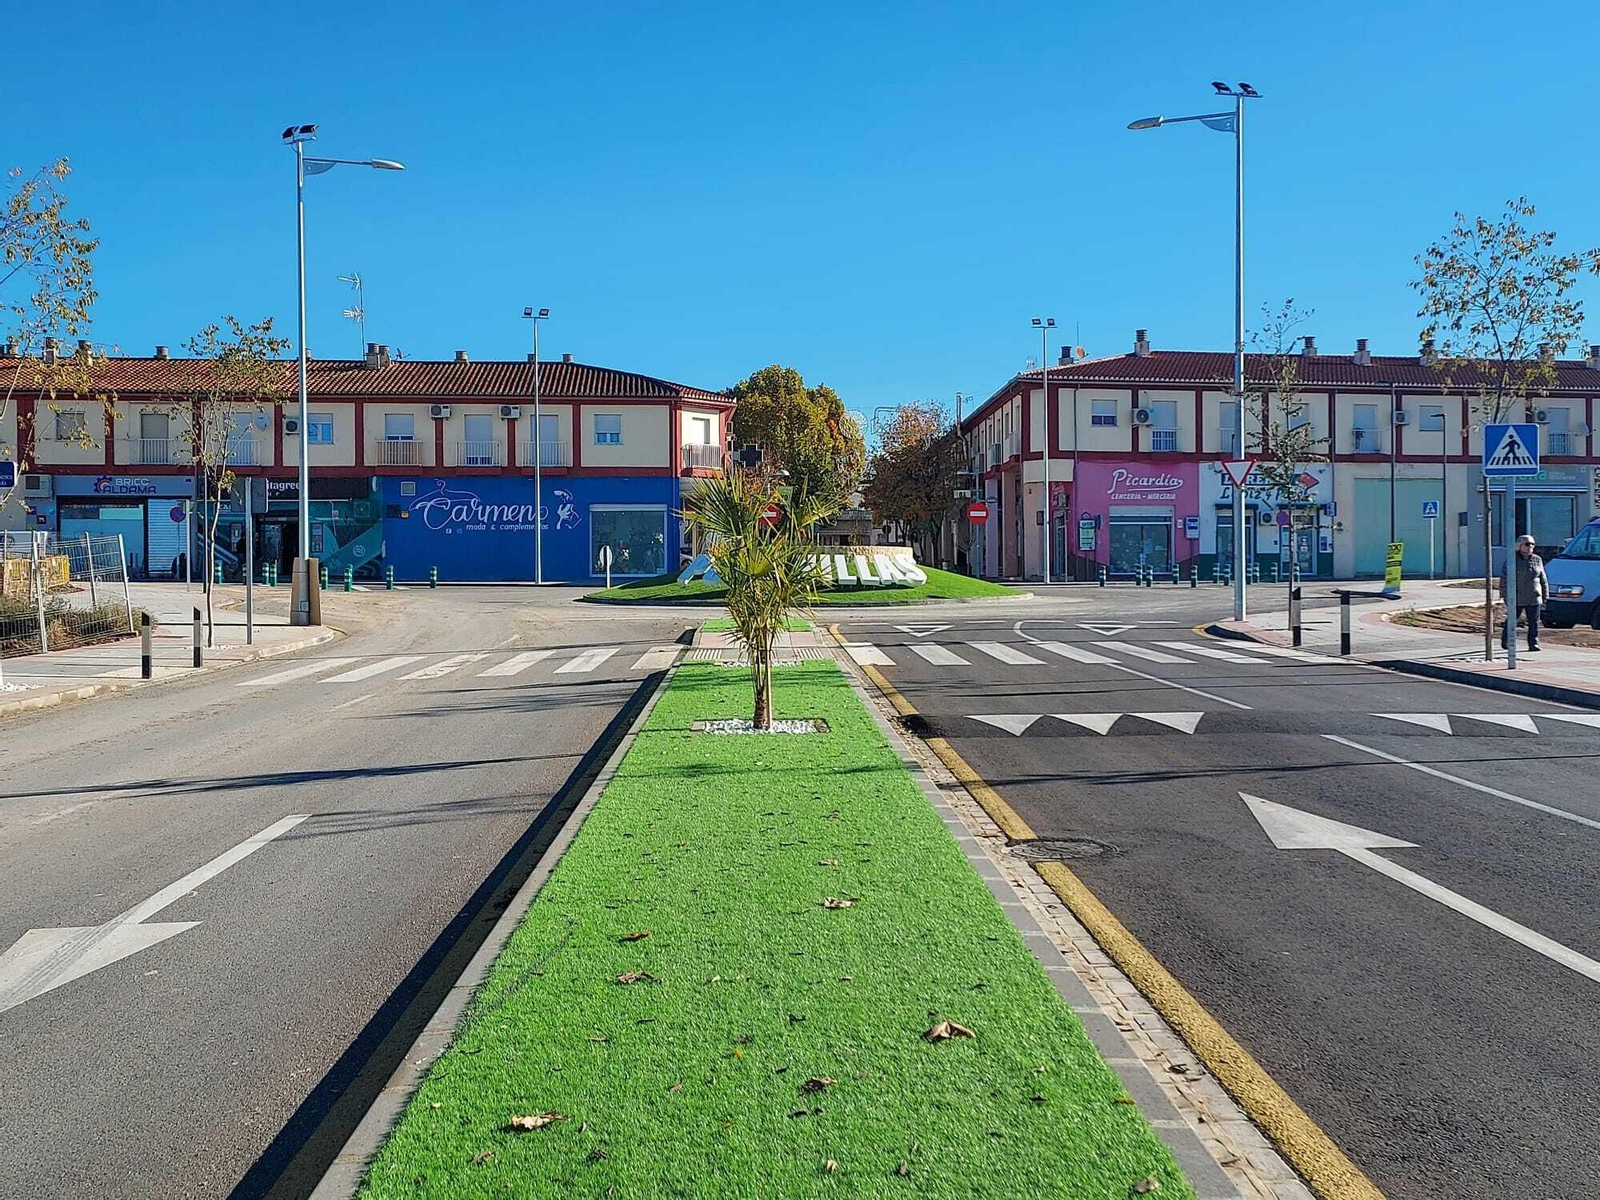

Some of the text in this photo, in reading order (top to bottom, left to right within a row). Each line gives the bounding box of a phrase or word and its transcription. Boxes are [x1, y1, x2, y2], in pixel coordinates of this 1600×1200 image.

[102, 485, 157, 494] ALDAMA
[415, 497, 549, 530] Carmen
[465, 523, 486, 531] moda
[499, 523, 549, 533] complemeos
